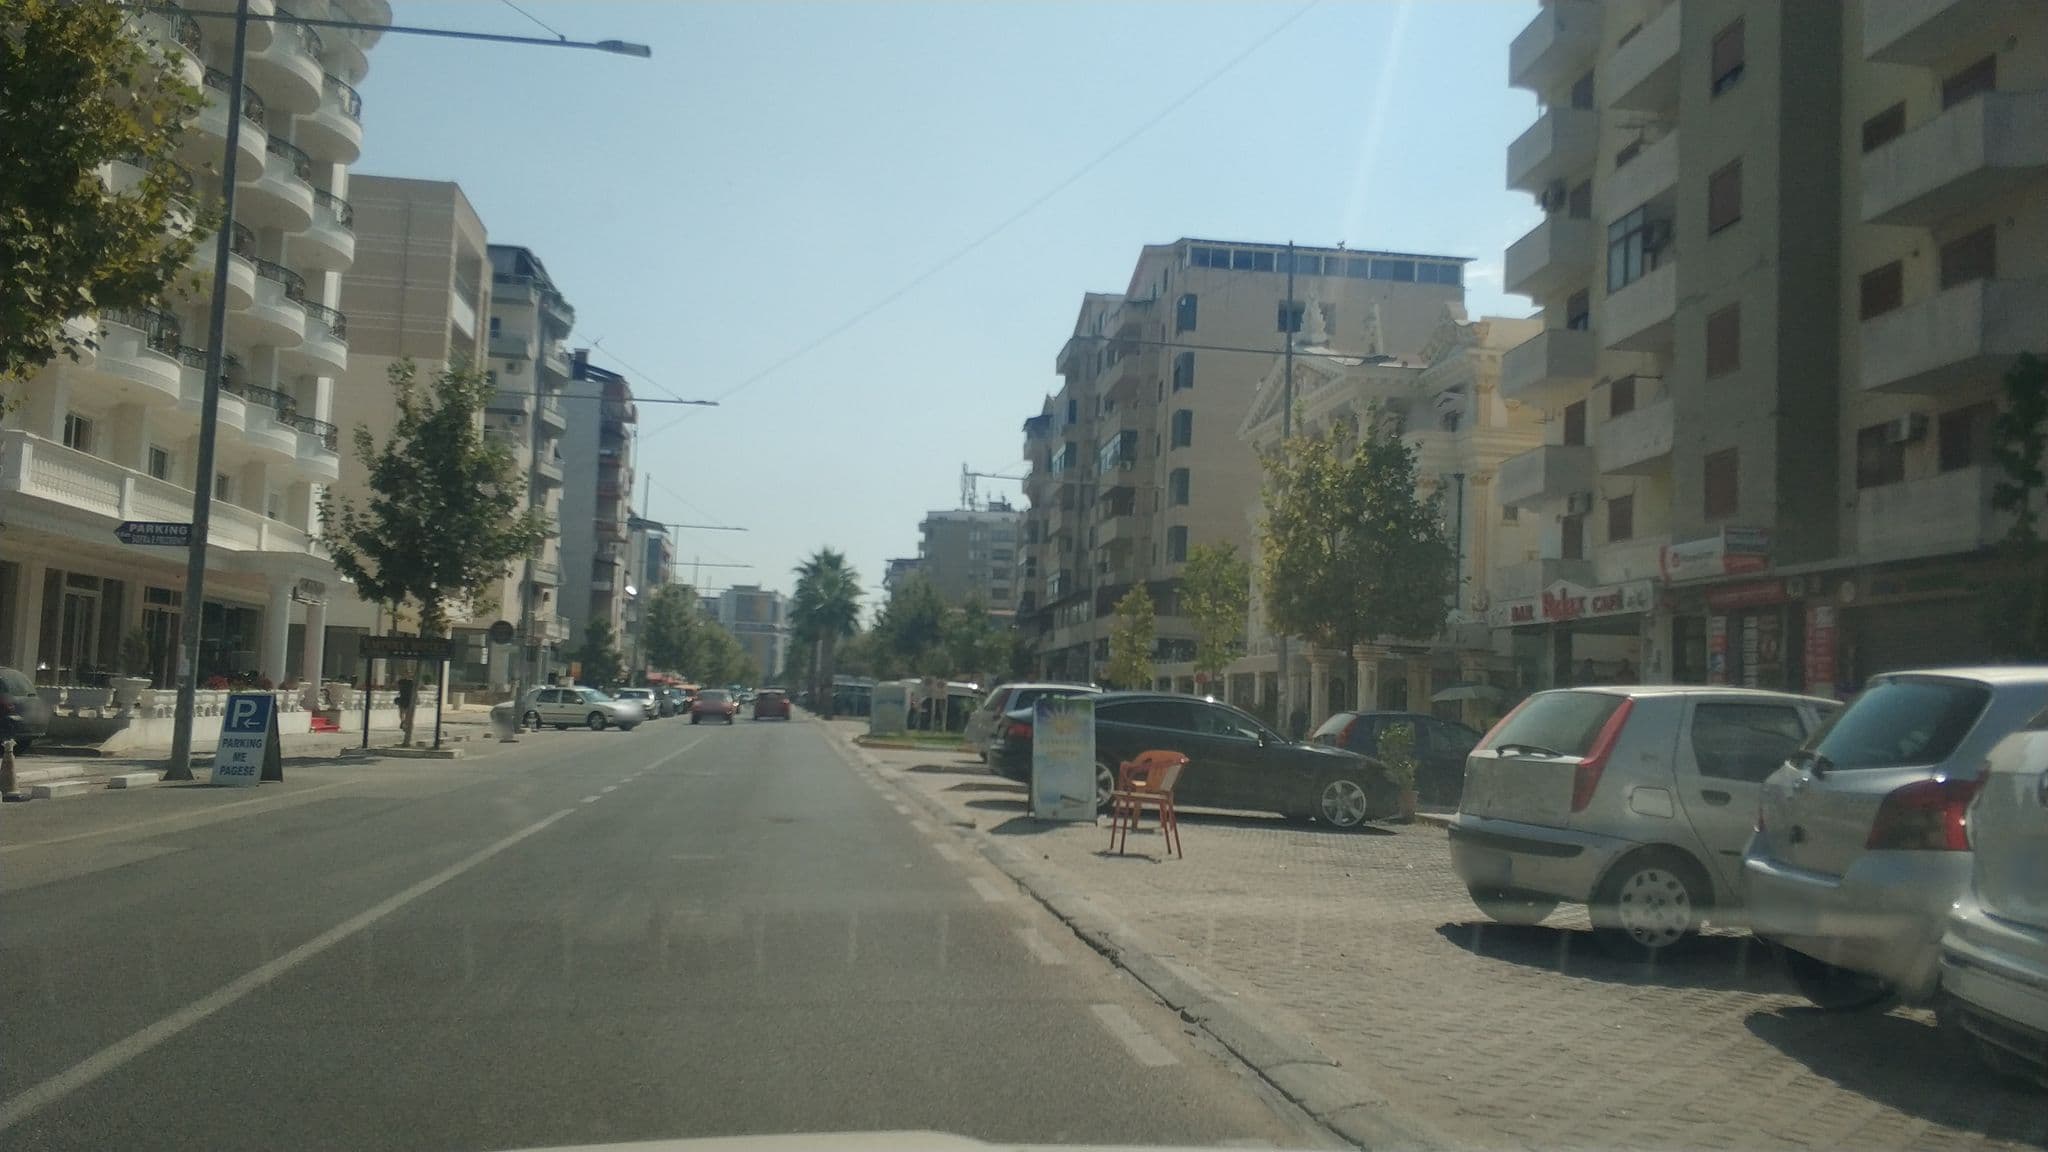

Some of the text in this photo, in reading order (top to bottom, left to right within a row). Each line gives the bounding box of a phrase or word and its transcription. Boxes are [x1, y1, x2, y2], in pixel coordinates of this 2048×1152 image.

[129, 523, 188, 535] PARKING
[231, 699, 257, 728] P
[222, 738, 262, 748] PARKING
[233, 752, 248, 762] ME
[220, 766, 256, 776] PAGESE
